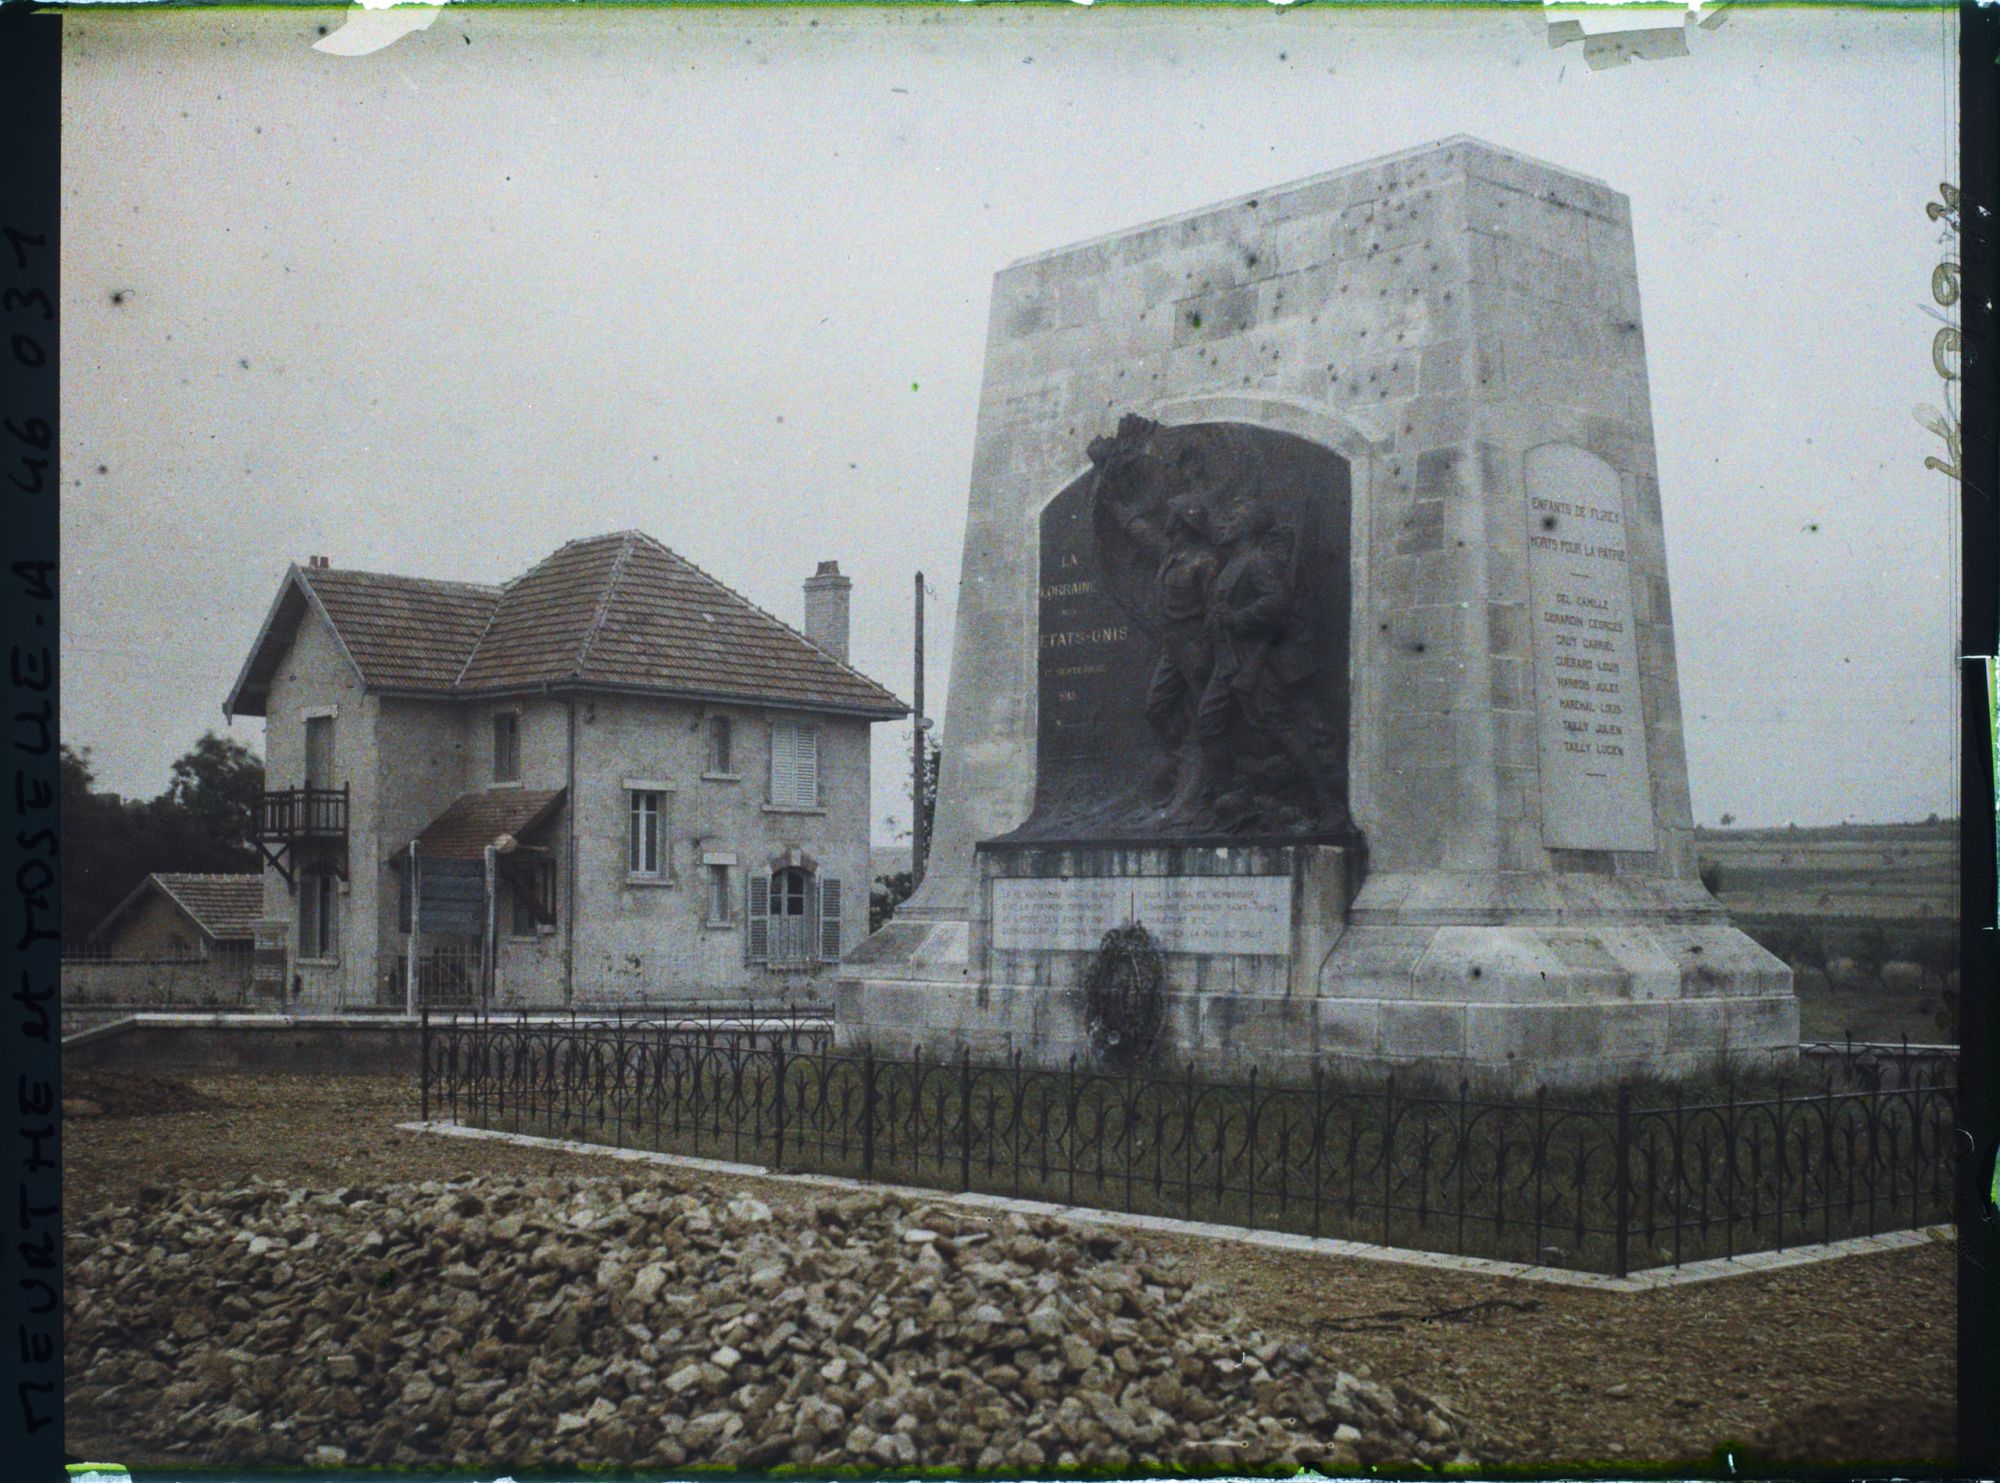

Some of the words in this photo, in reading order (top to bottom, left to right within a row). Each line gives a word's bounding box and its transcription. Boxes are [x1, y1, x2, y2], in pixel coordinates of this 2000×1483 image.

[2, 226, 54, 368] 031
[3, 416, 51, 494] 46
[1575, 505, 1586, 518] DE
[1061, 553, 1078, 568] LA
[1585, 544, 1595, 557] LA
[1040, 580, 1098, 599] LORRAINE
[1039, 625, 1129, 649] ETATS-UNIS
[12, 970, 55, 1042] et
[17, 1073, 58, 1435] MEURTHE
